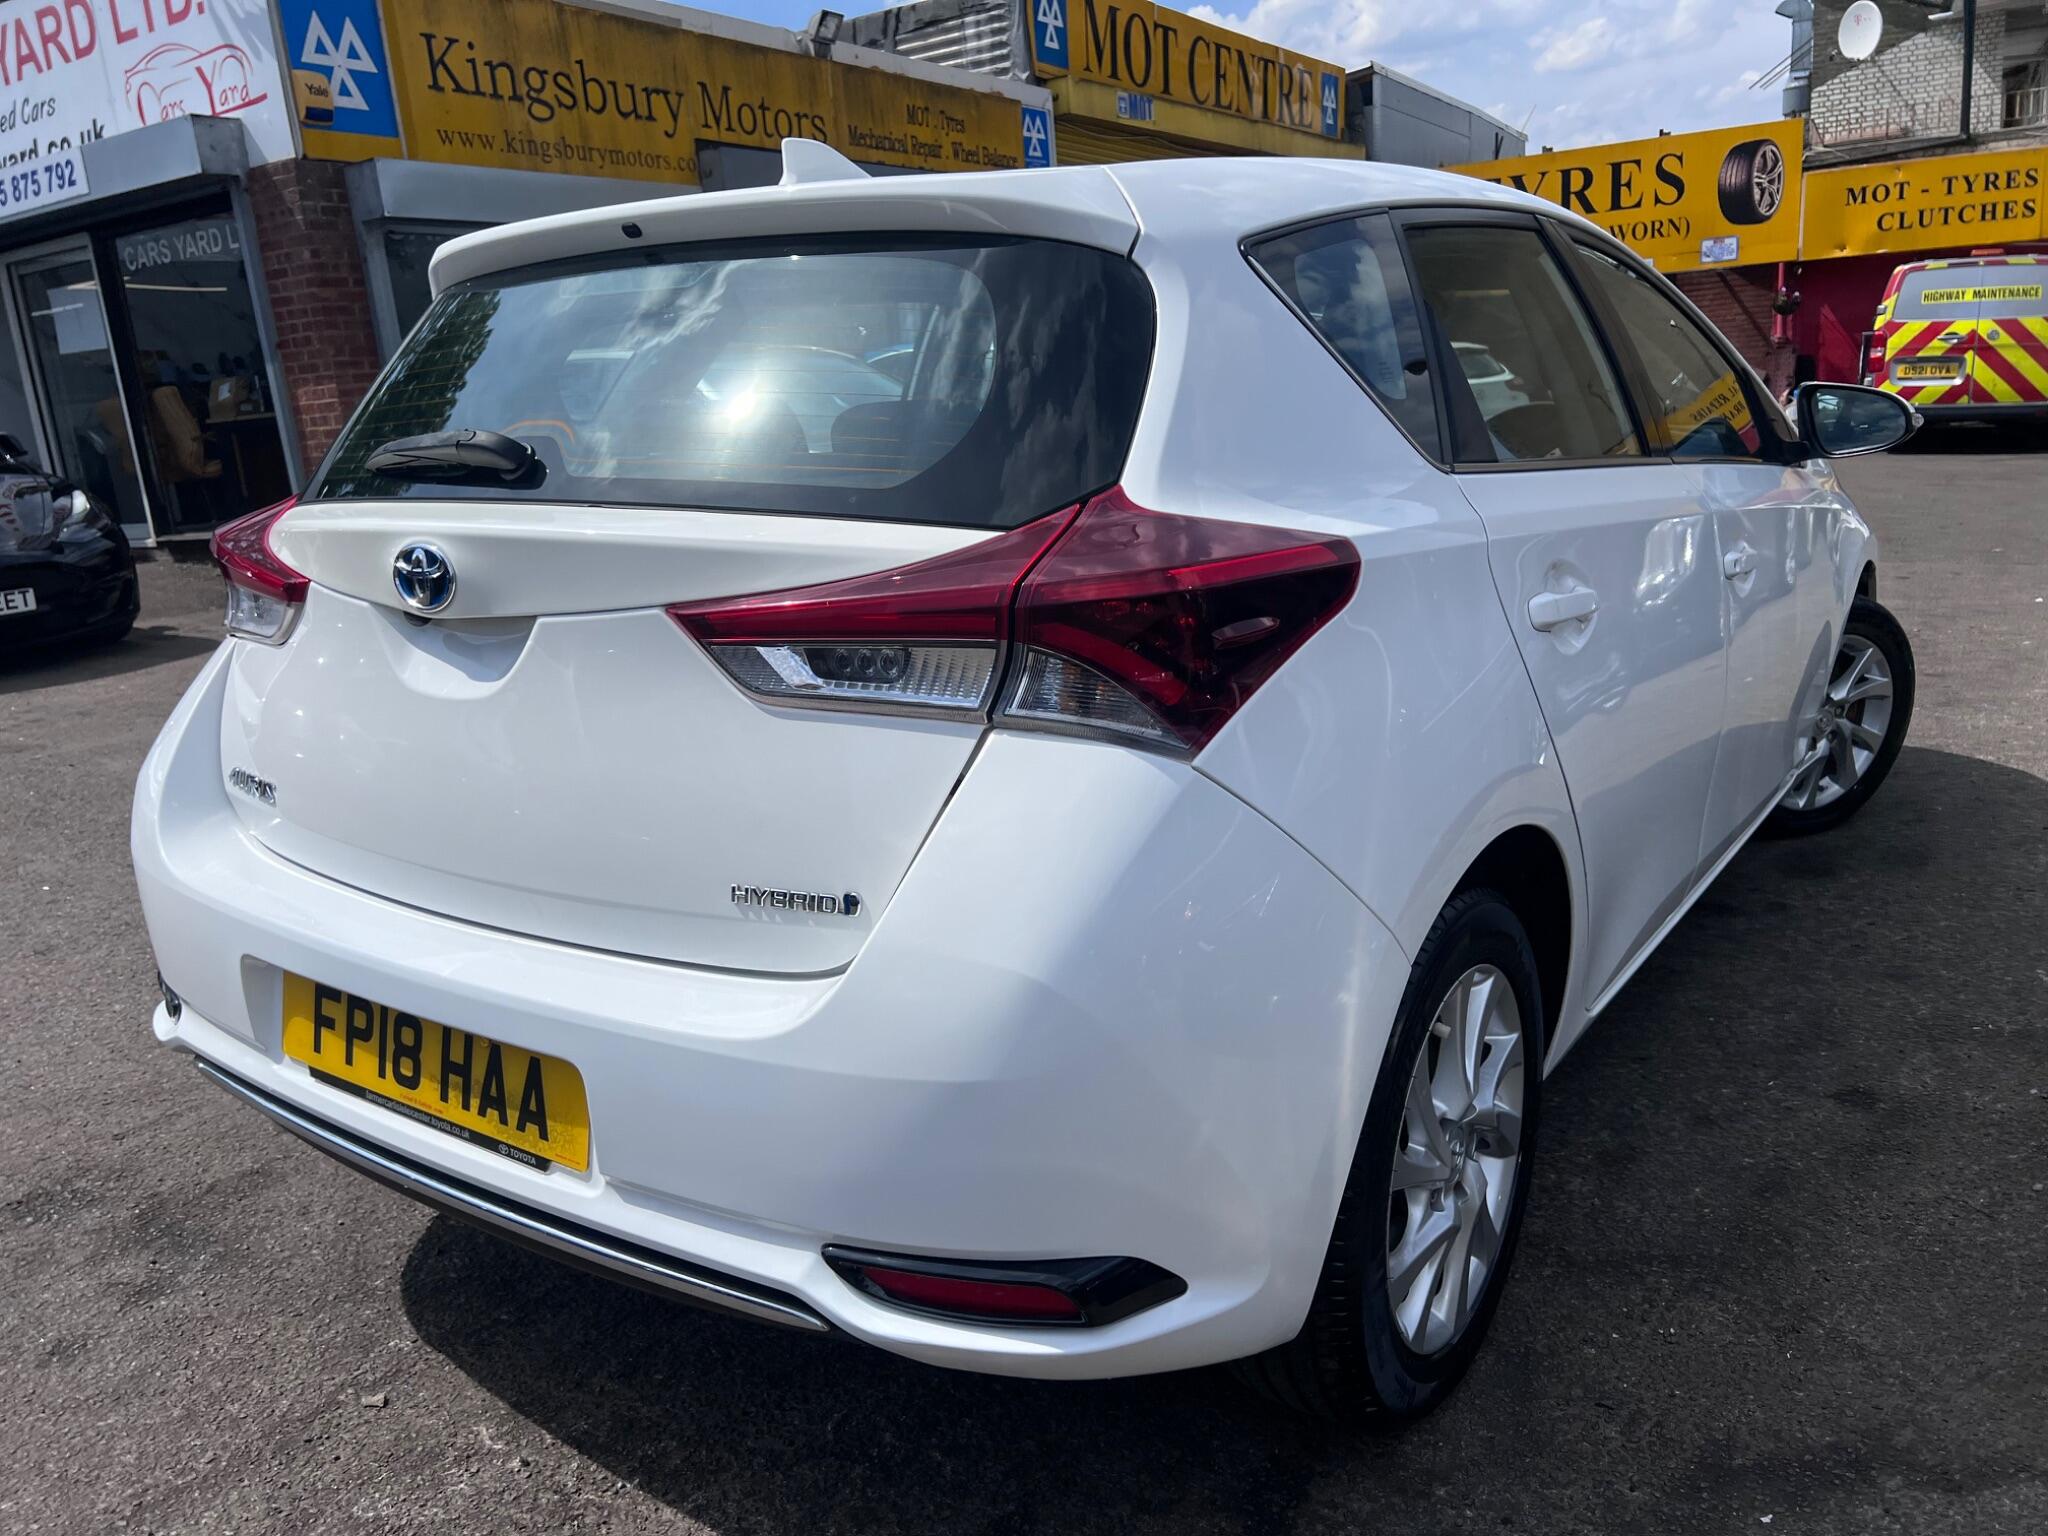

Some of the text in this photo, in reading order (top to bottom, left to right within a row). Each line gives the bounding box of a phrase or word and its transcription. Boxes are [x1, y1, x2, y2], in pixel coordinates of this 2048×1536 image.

[1083, 0, 1313, 128] MOT CENTRE
[305, 83, 329, 97] Yale
[419, 33, 828, 143] Kingsbury Motors
[21, 97, 56, 125] Cars
[907, 104, 930, 128] MOT
[940, 110, 965, 136] Tyres
[848, 124, 908, 154] Mechanical
[911, 135, 943, 162] Repair
[952, 142, 980, 164] Wheel
[11, 170, 41, 202] 875
[44, 159, 77, 192] 792
[1845, 181, 1910, 206] MOT
[1942, 168, 2039, 196] TYRES
[1876, 199, 2037, 232] CLUTCHES
[123, 239, 172, 271] CARS
[173, 227, 222, 260] YARD
[1923, 286, 2041, 303] HIGHWAY MAINTENANCE
[0, 590, 29, 611] ET
[731, 884, 839, 914] HYBRID
[313, 982, 550, 1142] FP18 HAA
[510, 1149, 536, 1166] TOYOTA
